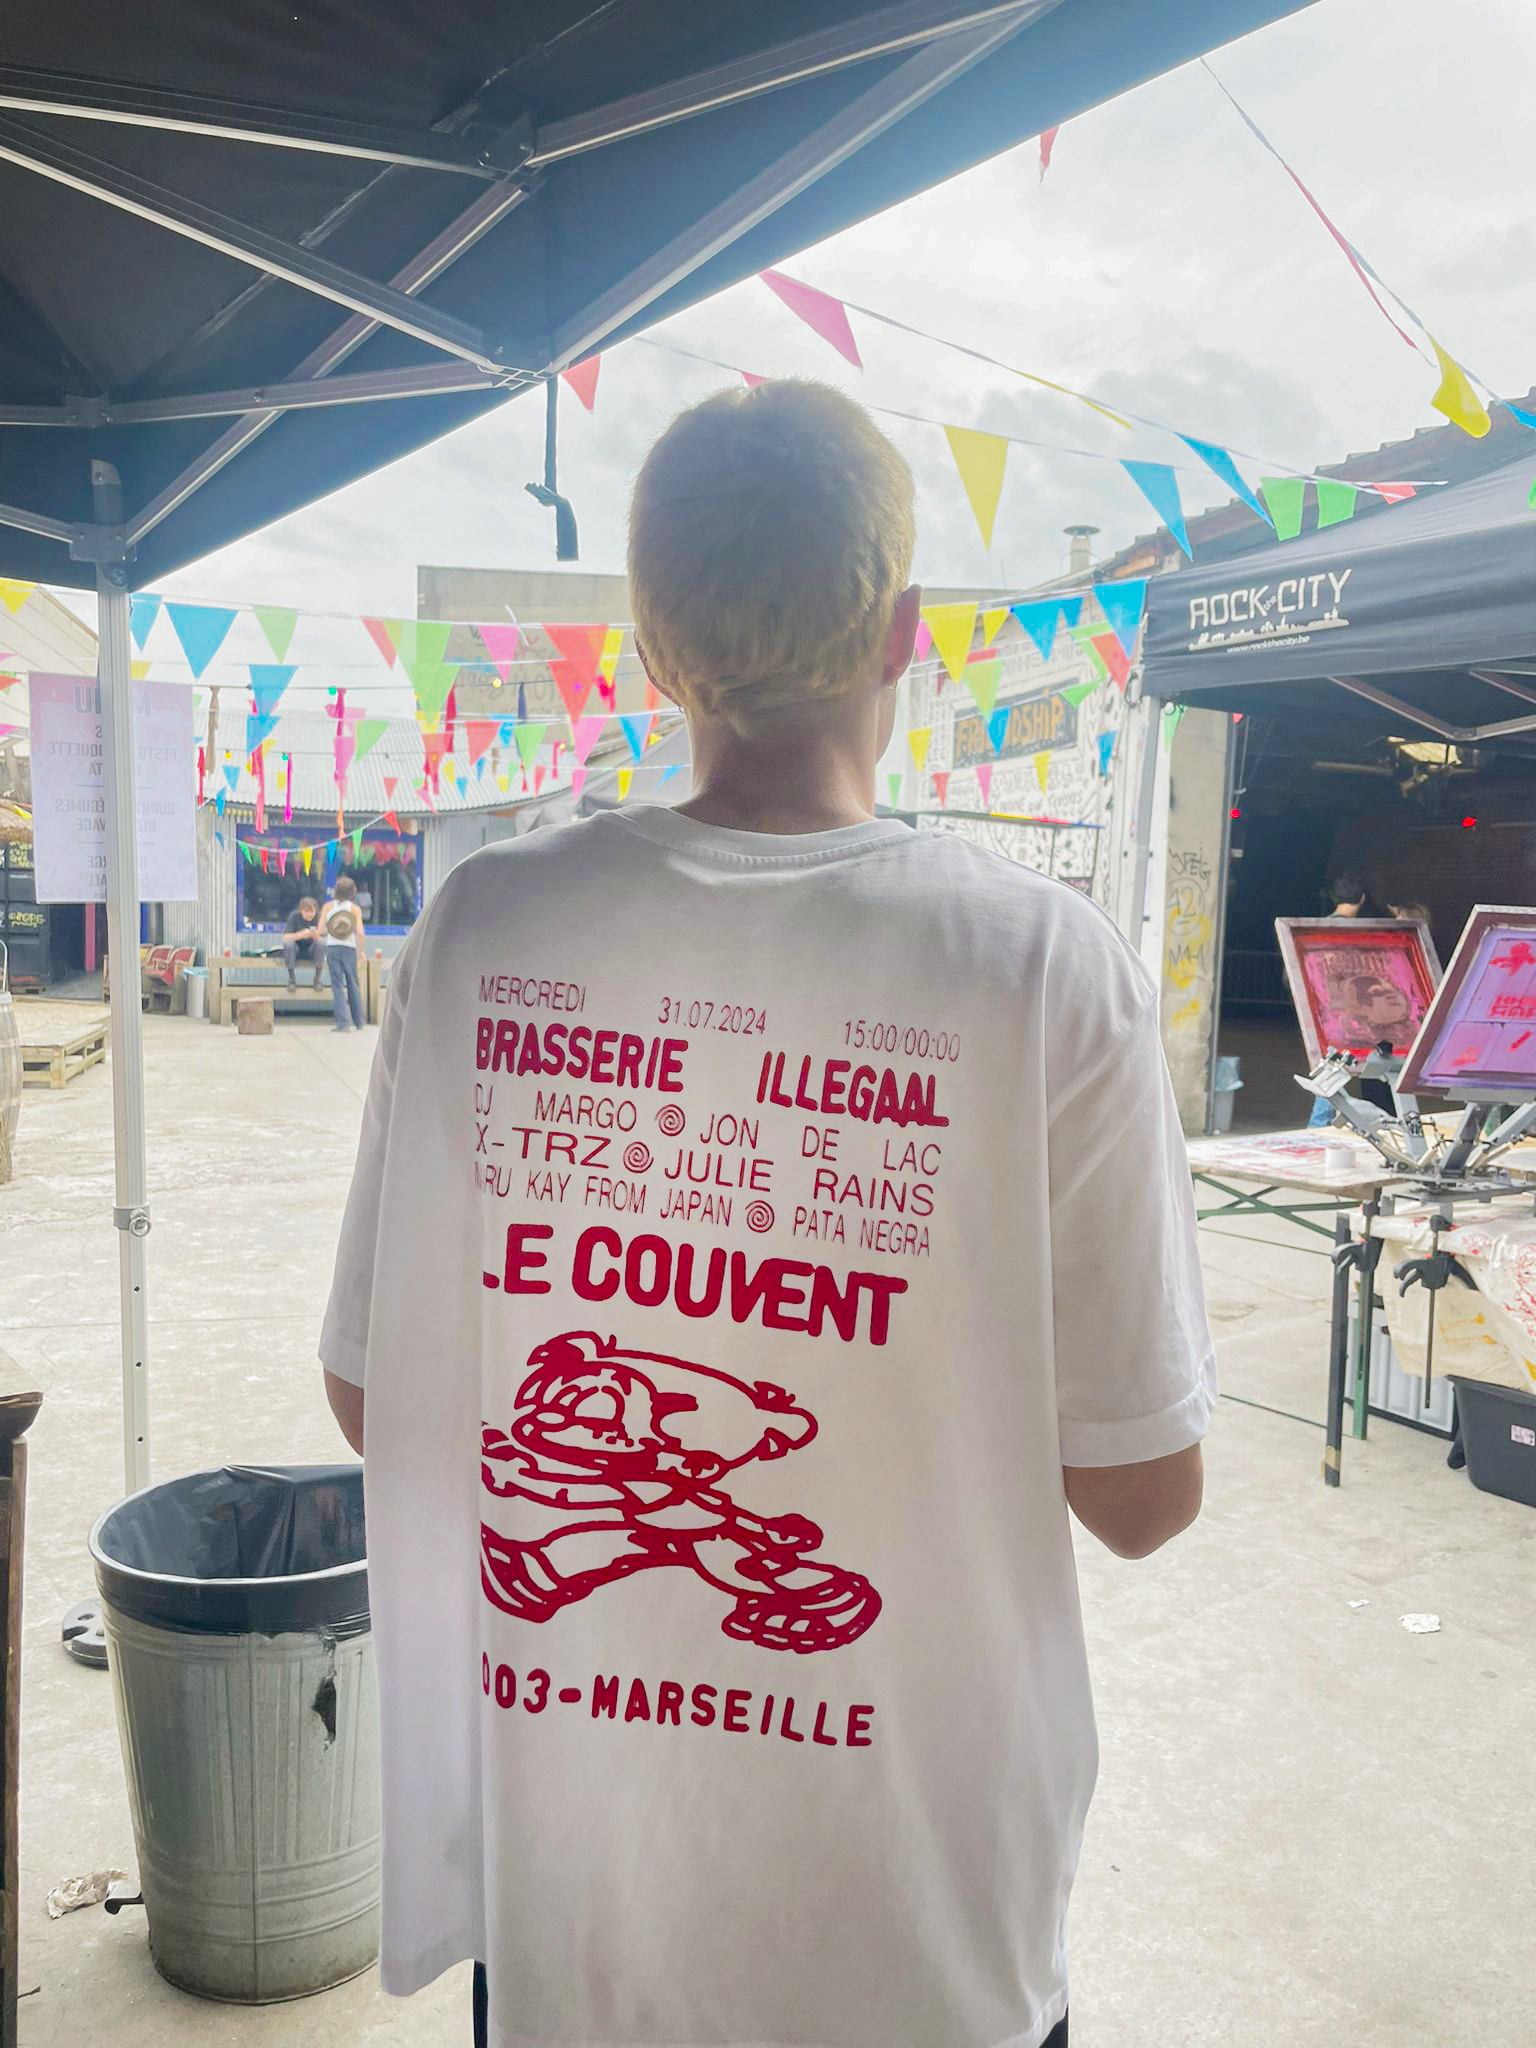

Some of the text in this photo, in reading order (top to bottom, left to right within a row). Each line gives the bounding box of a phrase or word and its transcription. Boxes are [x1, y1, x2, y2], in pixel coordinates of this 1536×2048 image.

[1189, 585, 1270, 630] ROCK
[1278, 568, 1352, 613] CITY
[479, 975, 961, 1062] MERCREDI 31.07.2024 15:00/00:00
[476, 1017, 950, 1128] BRASSERIE ILLEGAAL
[474, 1083, 942, 1176] DJ MARGO JON DE LAC
[526, 1169, 571, 1203] KAY
[584, 1175, 647, 1215] FROM
[659, 1187, 732, 1228] JAPAN
[793, 1206, 846, 1245] PATA
[859, 1217, 931, 1259] NEGRA
[664, 1149, 774, 1193] JULIE
[813, 1168, 935, 1217] RAINS
[483, 1223, 909, 1346] E COUVENT
